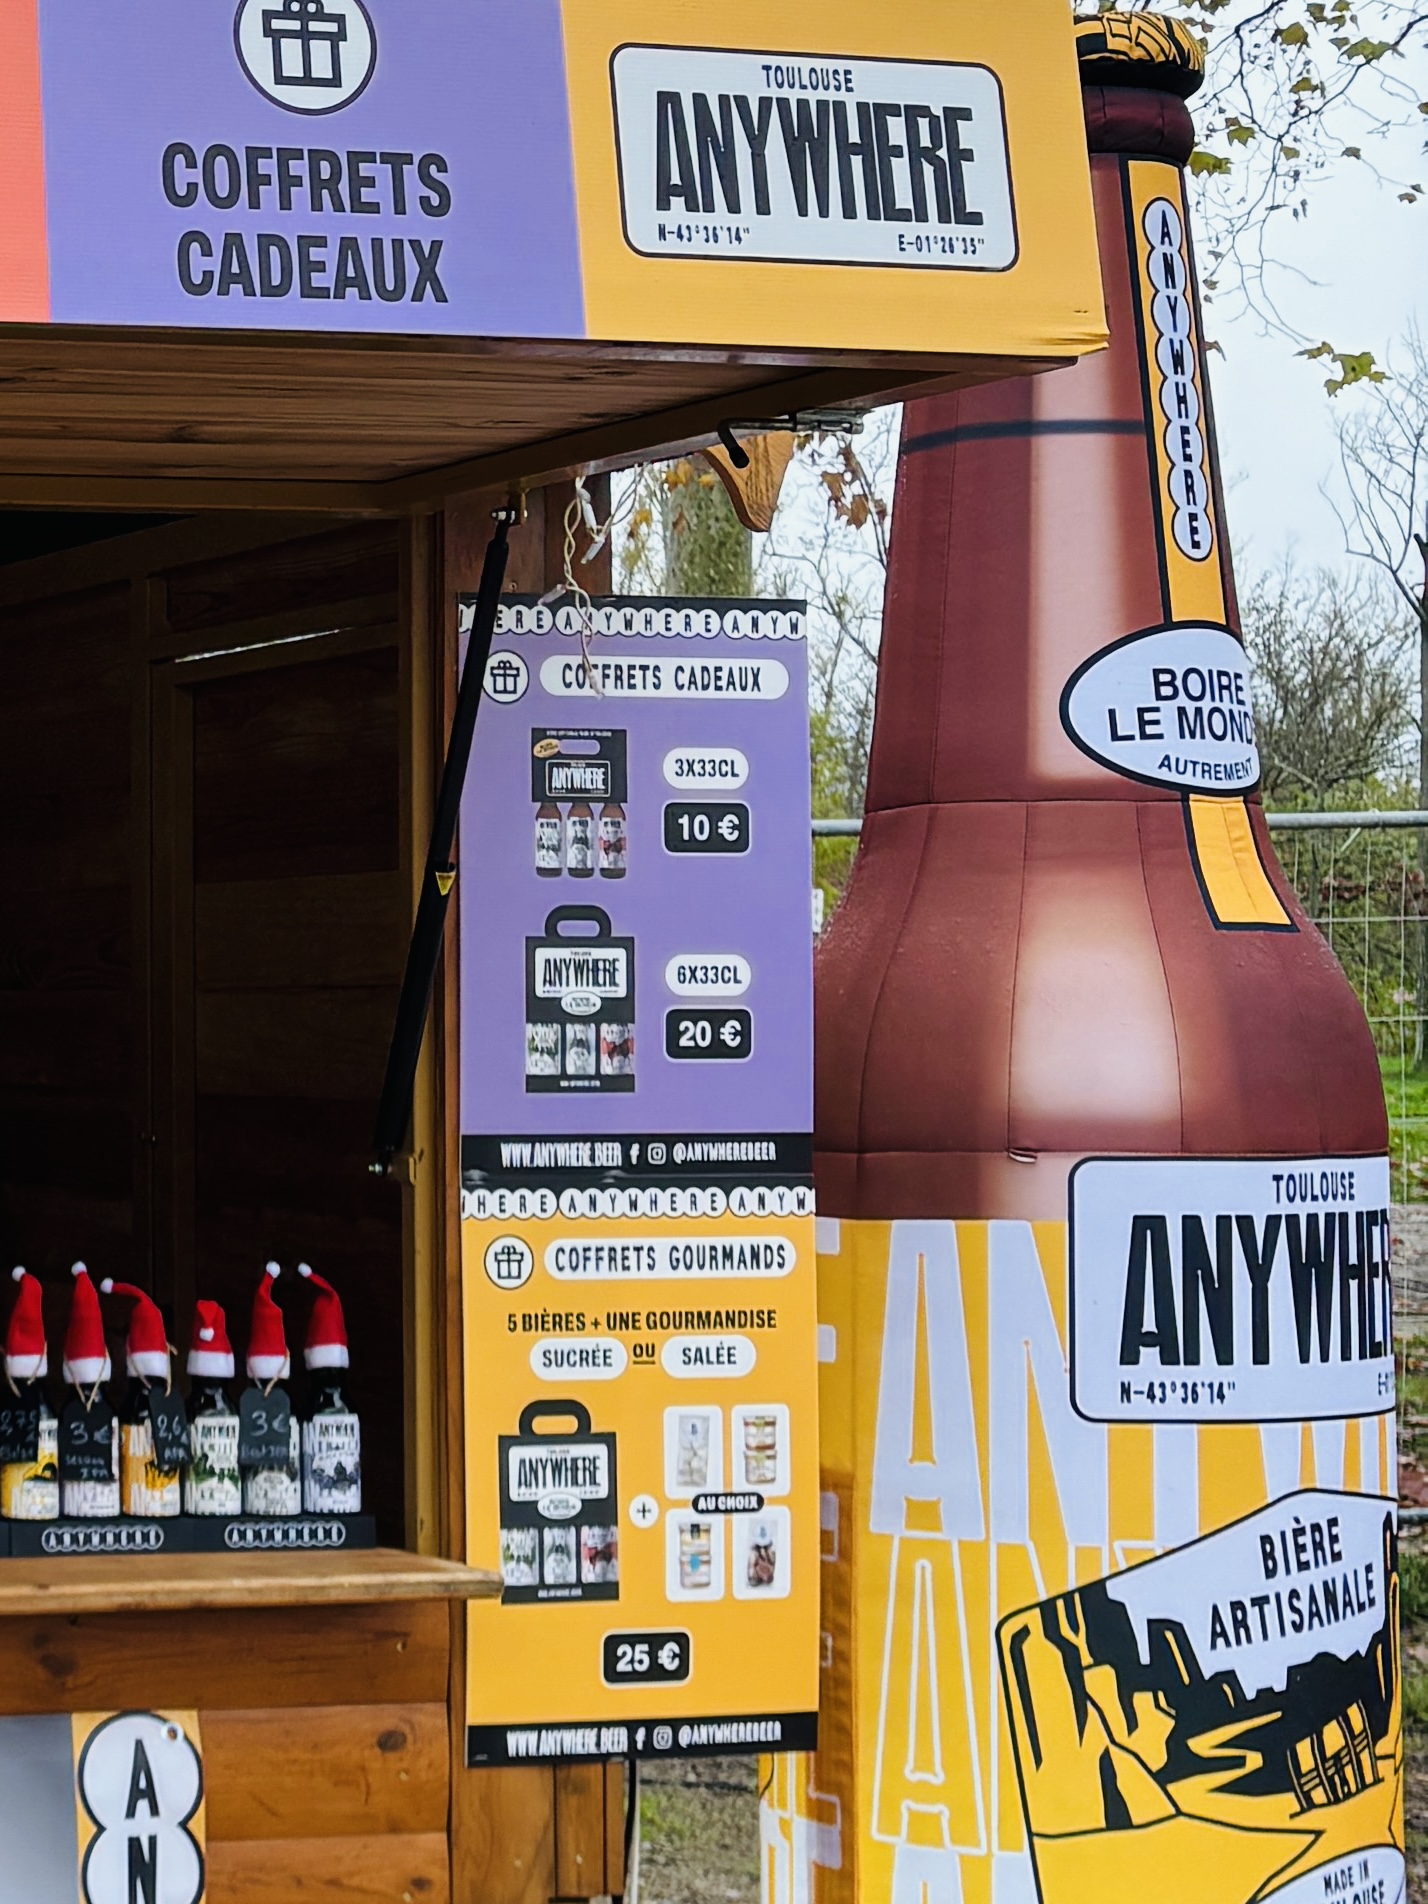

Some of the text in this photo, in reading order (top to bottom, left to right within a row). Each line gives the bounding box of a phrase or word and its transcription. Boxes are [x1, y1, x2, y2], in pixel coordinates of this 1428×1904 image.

[762, 64, 855, 92] TOULOUSE
[655, 90, 984, 226] ANYWHERE
[162, 141, 452, 219] COFFRETS
[178, 229, 450, 304] CADEAUX
[1157, 219, 1204, 553] ANYWHERE
[674, 665, 762, 692] CADEAUX
[1153, 667, 1245, 705] BOIRE
[1108, 706, 1253, 745] LE MOND
[675, 759, 740, 778] 3X33CL
[1157, 754, 1252, 780] AUTREMENT
[542, 957, 620, 988] ANYWHERE
[677, 965, 742, 985] 6X33CL
[501, 1142, 623, 1168] WWW.ANYWHERE.BEER
[568, 1191, 718, 1213] ANYWHERE
[1272, 1171, 1355, 1204] TOULOUSE
[555, 1244, 786, 1272] COFFRETS GOURMANDS
[522, 1308, 777, 1332] BIÈRES UNE GOURMANDISE
[542, 1341, 737, 1368] SUCRÉE SALÉE
[518, 1456, 601, 1489] ANYWHERE
[1260, 1516, 1342, 1580] BIÈRE
[1209, 1562, 1376, 1650] ARTISANALE
[506, 1727, 628, 1757] WWW.ANYWHERE.BEER
